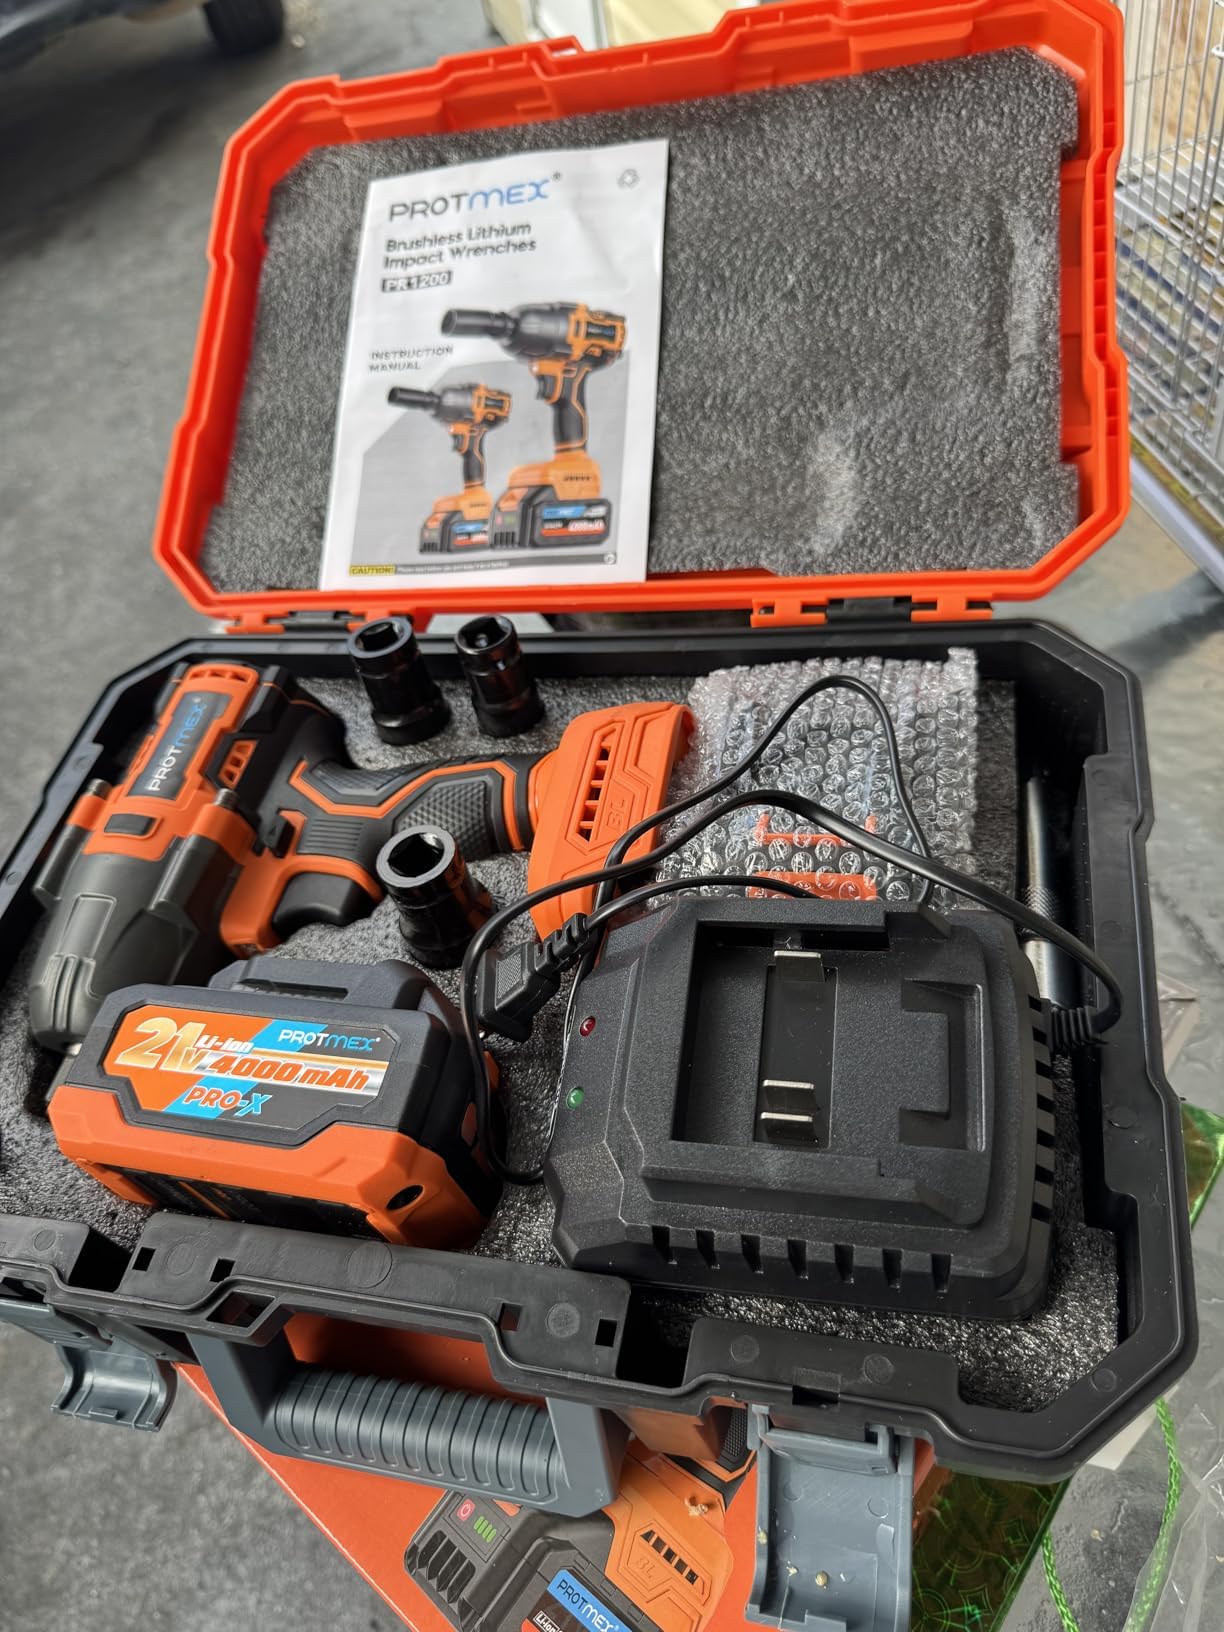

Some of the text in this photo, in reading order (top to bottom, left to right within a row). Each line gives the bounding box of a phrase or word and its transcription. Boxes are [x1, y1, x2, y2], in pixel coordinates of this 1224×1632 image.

[389, 178, 550, 222] PROTMEX
[386, 222, 532, 253] Brushless Lithium
[383, 239, 537, 269] Impact Wrenches
[368, 361, 422, 372] MANUAL
[370, 345, 454, 360] INSTRUCTION
[144, 703, 207, 791] PROTMEX
[196, 1034, 254, 1055] Li-ion
[277, 1028, 375, 1052] PROTMEX
[182, 1086, 273, 1117] PRO-X
[556, 1578, 614, 1632] PROTMEX
